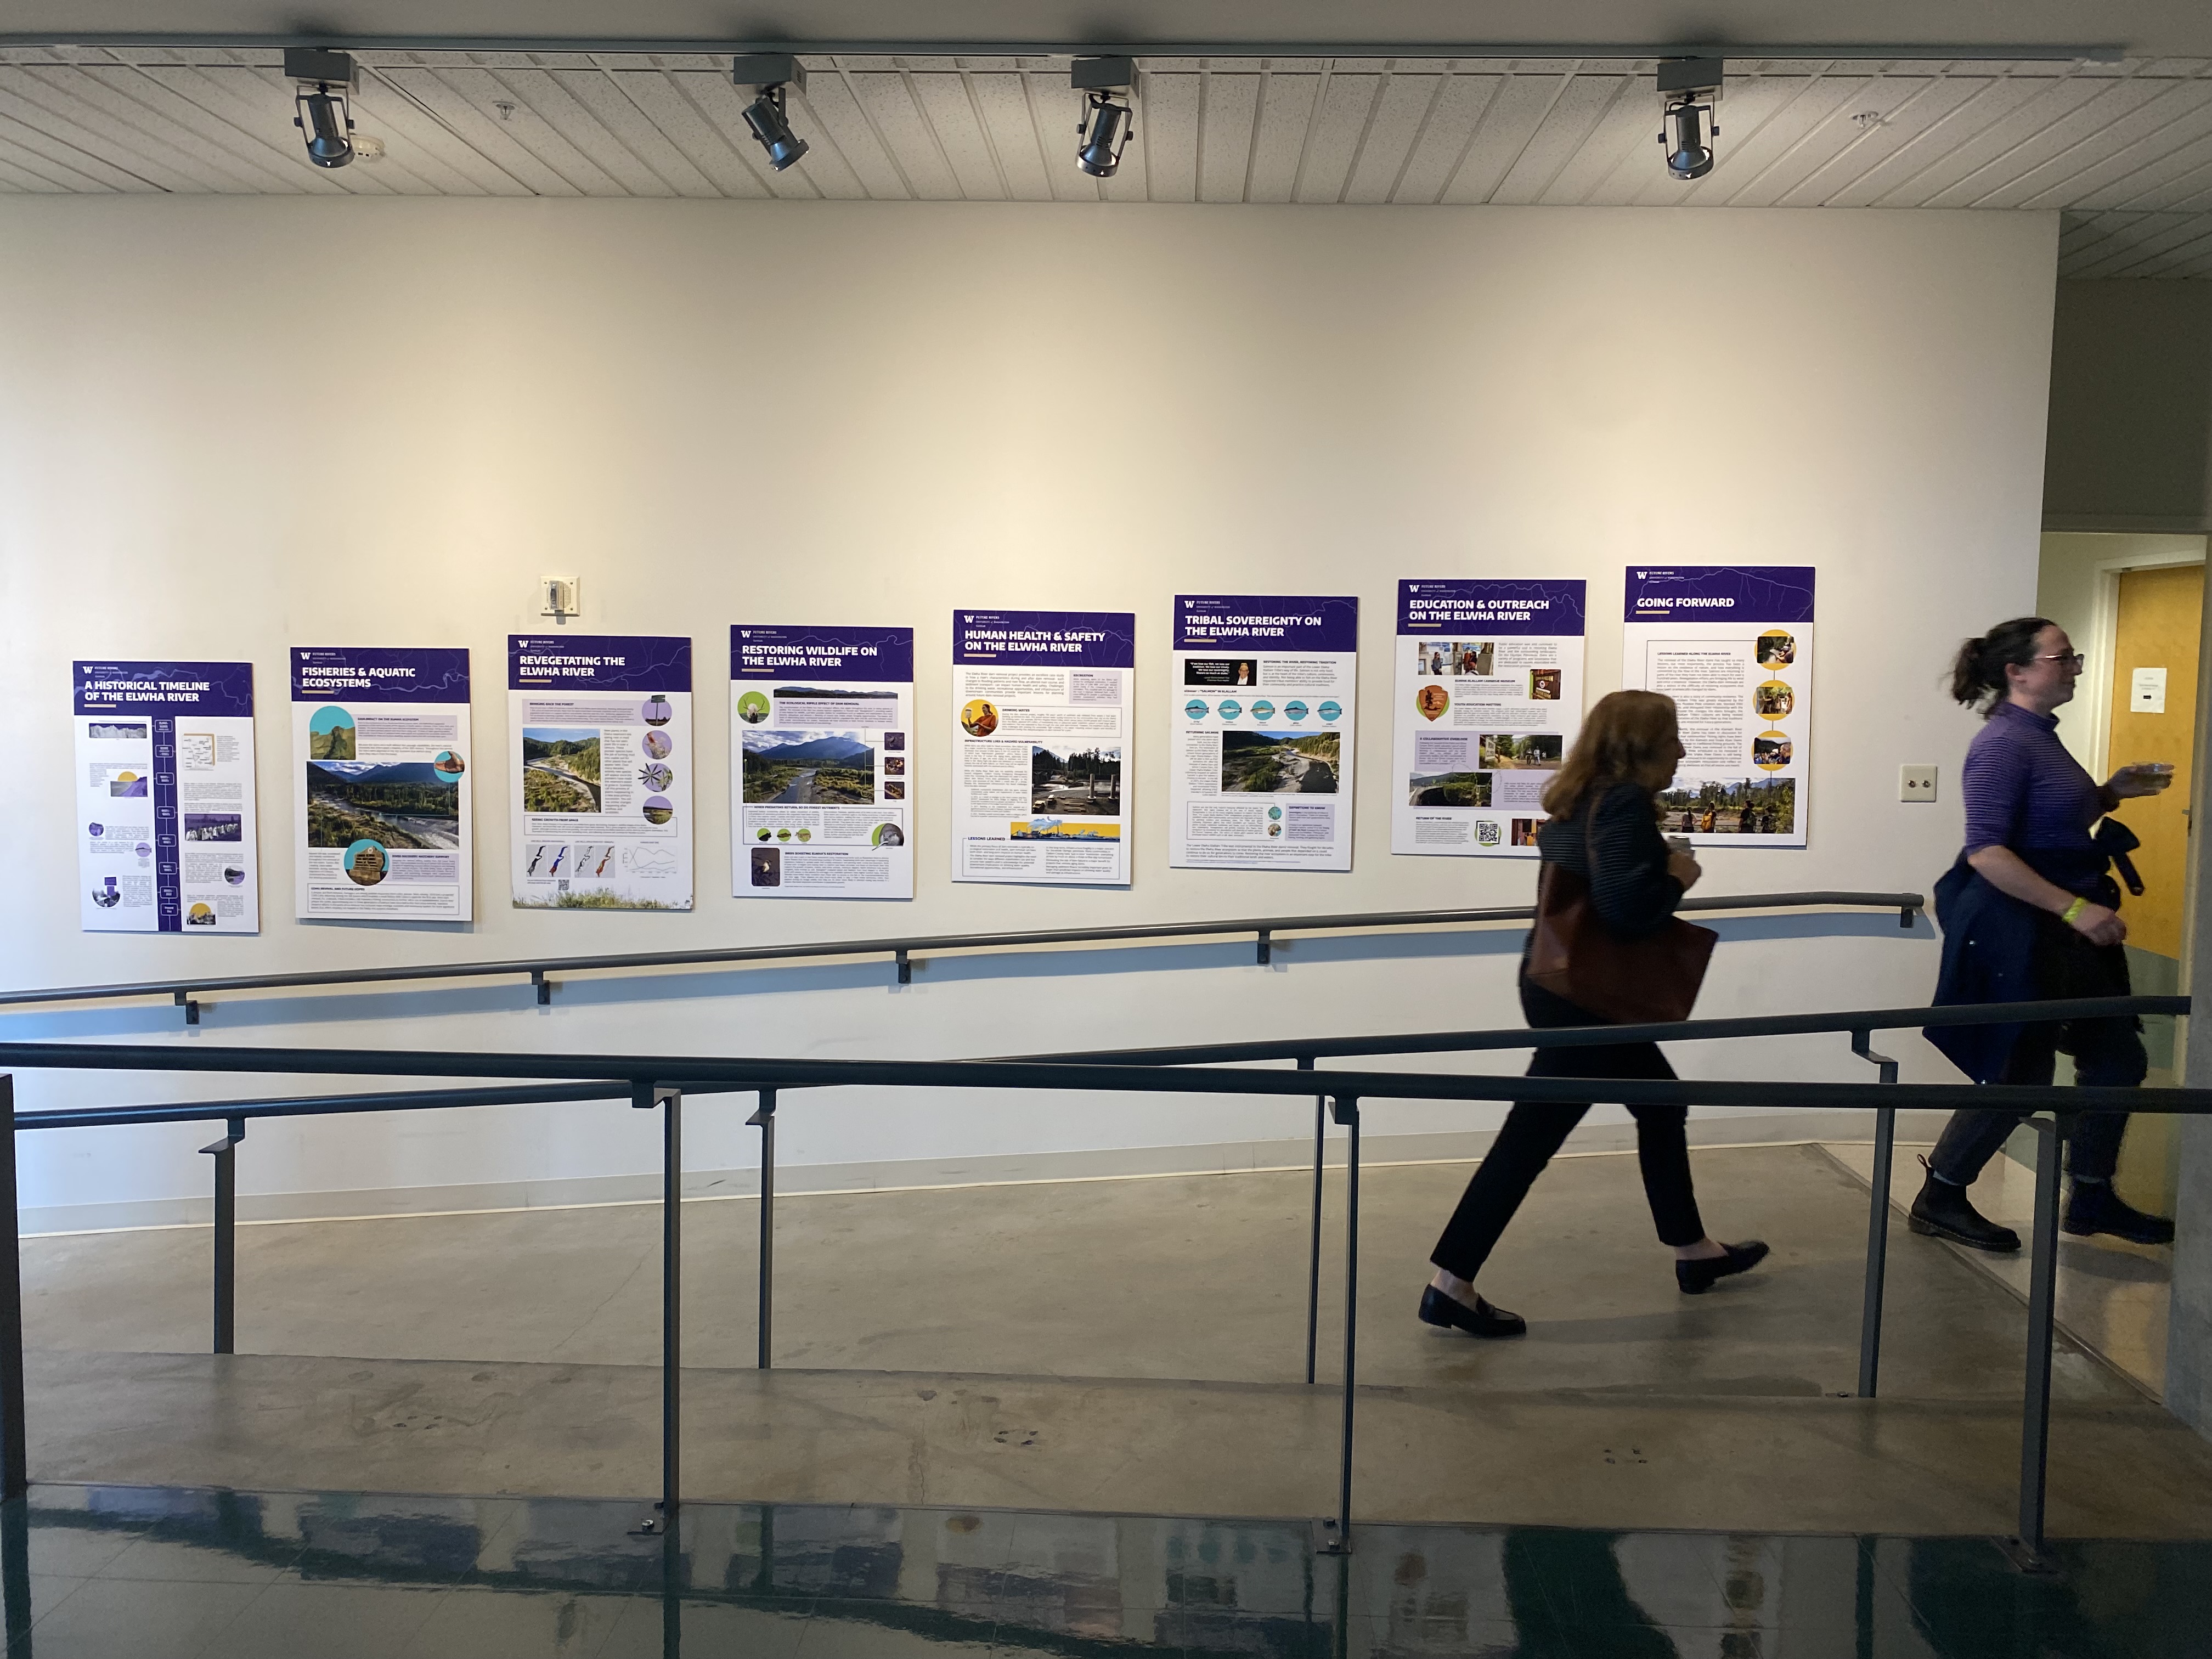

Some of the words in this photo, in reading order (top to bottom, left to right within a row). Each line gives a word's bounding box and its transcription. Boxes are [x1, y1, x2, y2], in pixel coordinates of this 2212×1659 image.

[1409, 600, 1473, 609] EDUCATION
[1476, 600, 1486, 609] &
[1488, 600, 1549, 610] OUTREACH
[1637, 598, 1673, 607] GOING
[1676, 598, 1735, 607] FORWARD
[1185, 615, 1224, 624] TRIBAL
[1226, 616, 1302, 625] SOVEREIGNTY
[1305, 617, 1322, 625] ON
[1409, 611, 1426, 620] ON
[1429, 611, 1451, 620] THE
[1454, 611, 1495, 620] ELWHA
[1497, 612, 1531, 620] RIVER
[965, 630, 1007, 640] HUMAN
[1009, 631, 1051, 640] HEALTH
[1053, 632, 1062, 641] &
[1064, 632, 1105, 641] SAFETY
[1185, 627, 1207, 635] THE
[1209, 627, 1250, 636] ELWHA
[1252, 628, 1284, 636] RIVER
[742, 646, 803, 655] RESTORING
[805, 646, 858, 656] WILDLIFE
[861, 647, 877, 656] ON
[965, 641, 981, 651] ON
[984, 642, 1006, 651] THE
[1008, 642, 1048, 652] ELWHA
[1050, 643, 1082, 652] RIVER
[520, 656, 601, 665] REVEGETATING
[603, 657, 625, 665] THE
[742, 657, 764, 665] THE
[767, 657, 807, 666] ELWHA
[809, 658, 842, 667] RIVER
[302, 667, 356, 676] FISHERIES
[358, 668, 366, 676] &
[369, 668, 415, 678] AQUATIC
[520, 667, 560, 676] ELWHA
[562, 667, 595, 676] RIVER
[84, 681, 93, 690] A
[95, 681, 157, 690] HISTORICAL
[159, 681, 210, 691] TIMELINE
[302, 678, 371, 687] ECOSYSTEMS
[85, 692, 99, 701] OF
[103, 692, 123, 701] THE
[126, 692, 165, 701] ELWHA
[168, 693, 199, 702] RIVER
